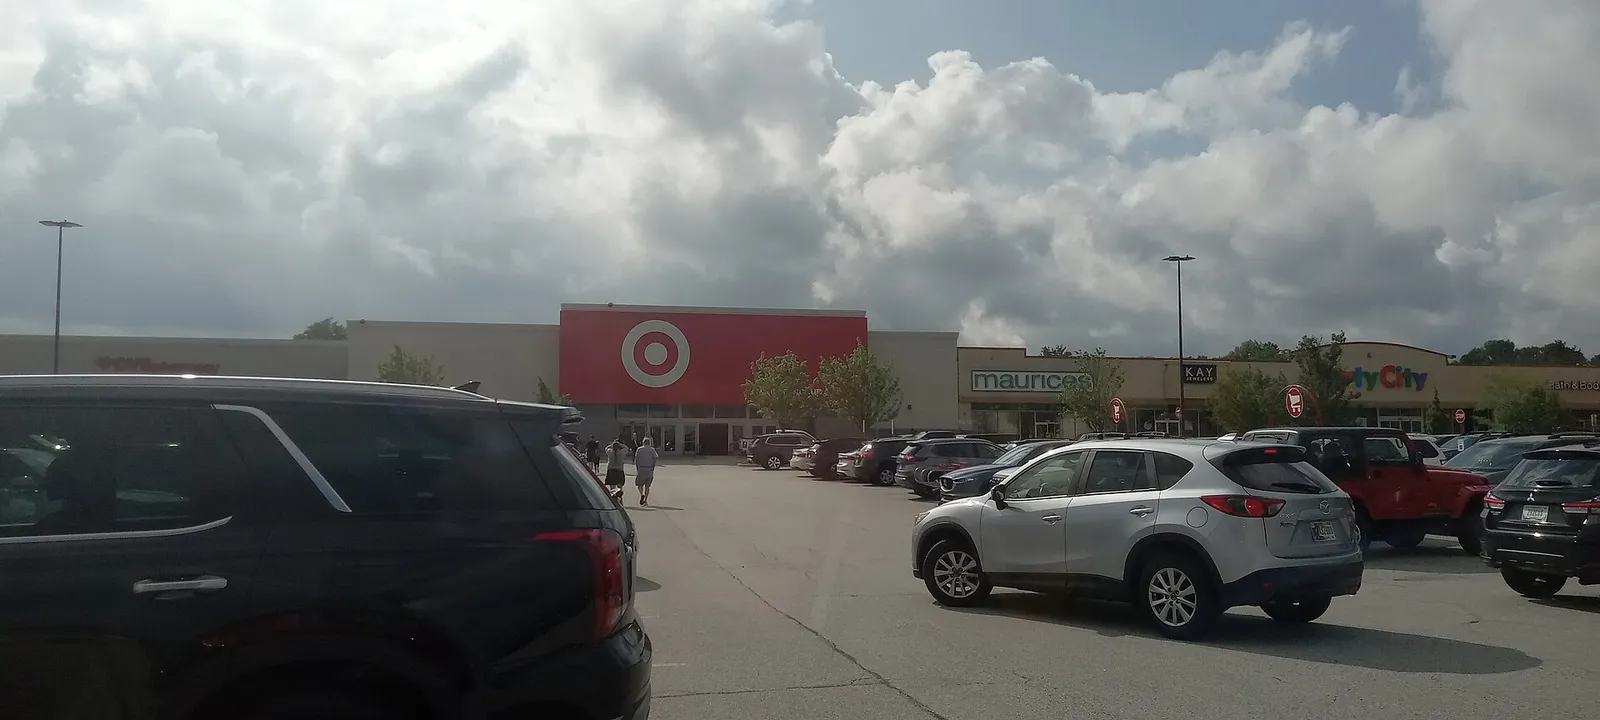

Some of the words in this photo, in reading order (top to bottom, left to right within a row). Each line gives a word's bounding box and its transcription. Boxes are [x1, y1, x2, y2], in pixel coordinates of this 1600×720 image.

[1185, 367, 1213, 377] KAY
[1380, 365, 1428, 392] City
[1579, 380, 1600, 390] Bod
